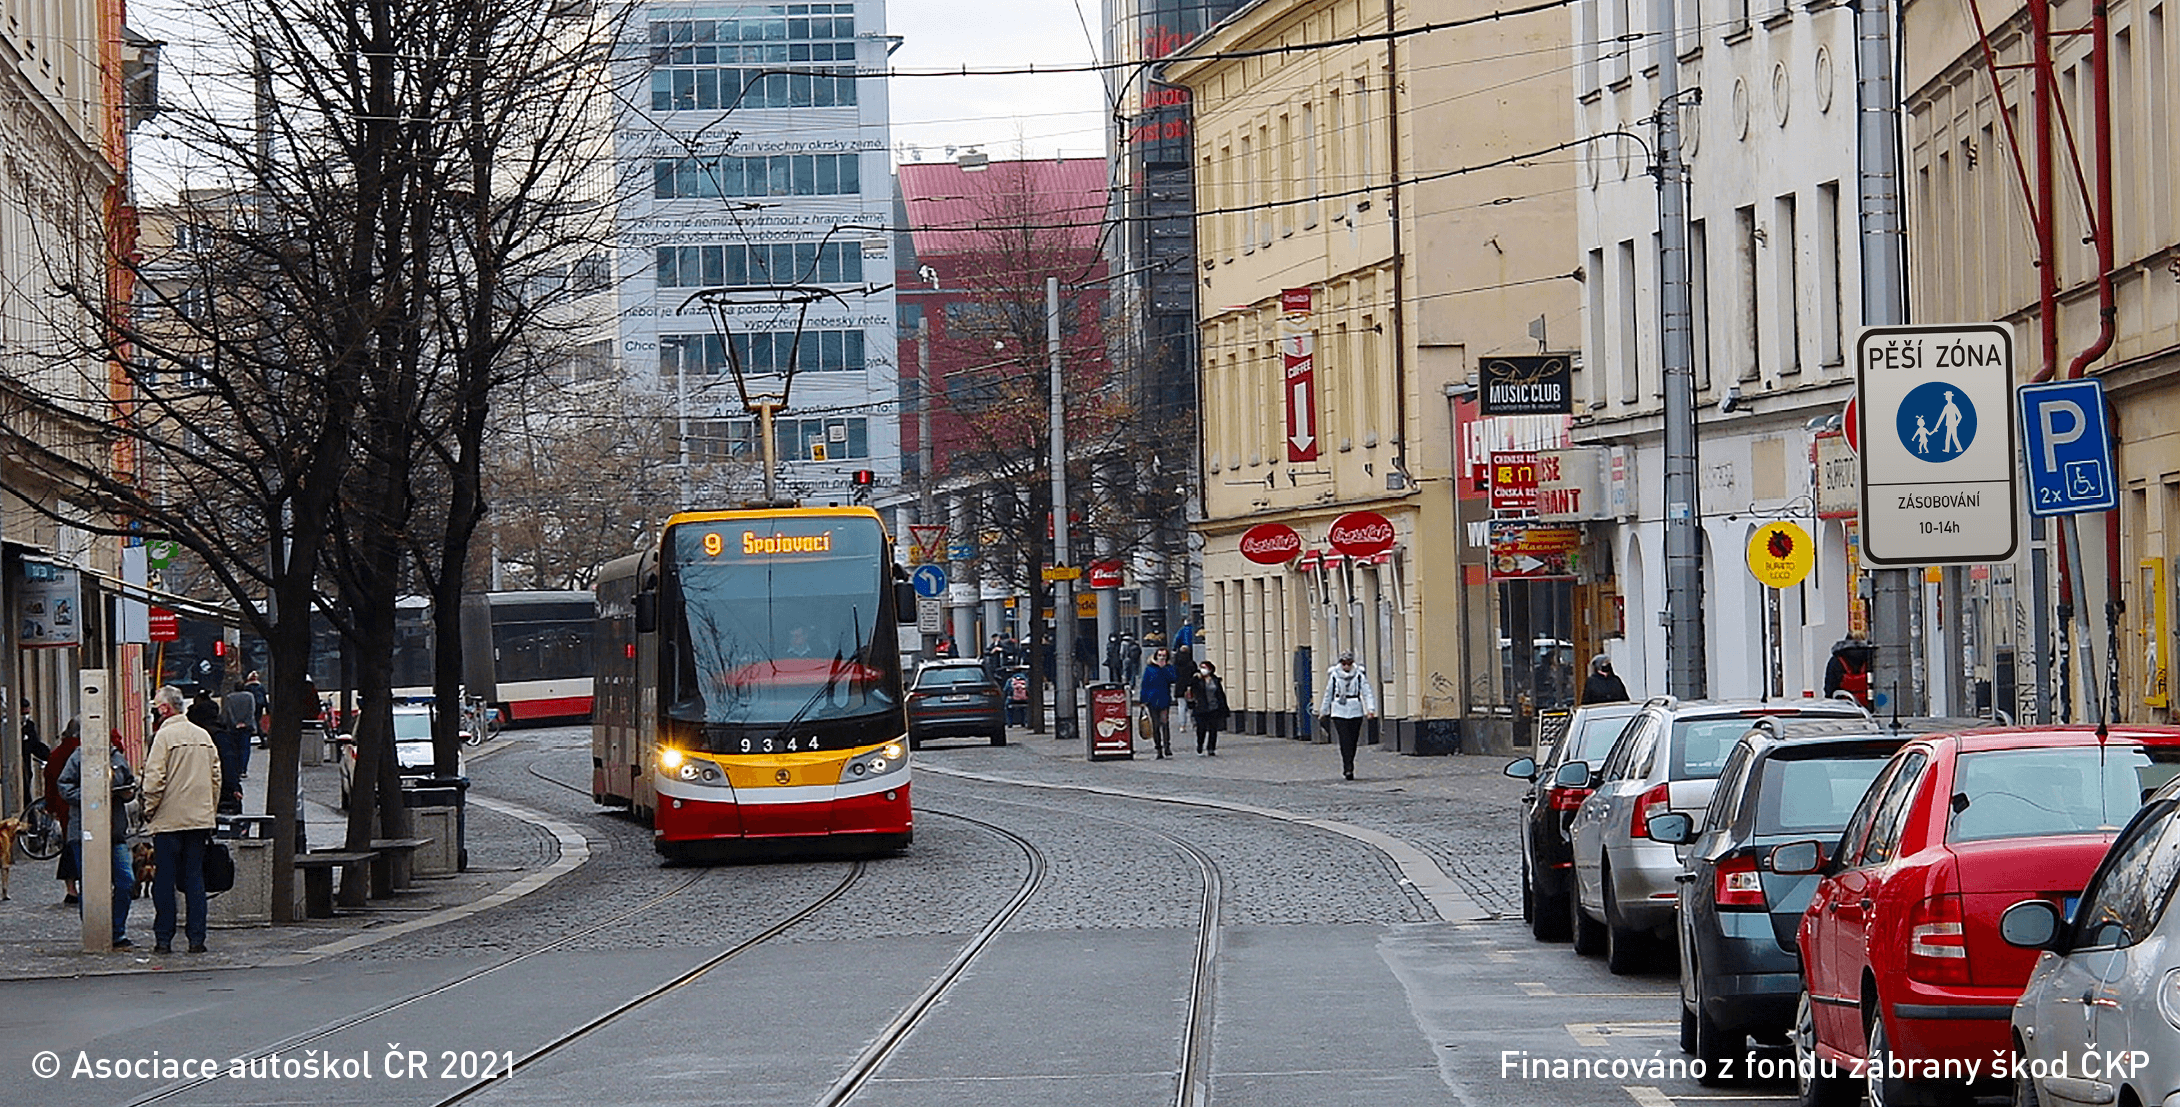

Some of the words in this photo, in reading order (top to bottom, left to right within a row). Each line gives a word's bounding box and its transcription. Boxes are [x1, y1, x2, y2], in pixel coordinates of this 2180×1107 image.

[757, 140, 806, 152] všechny
[808, 139, 846, 150] okrsky
[1869, 340, 1923, 370] PĚŠÍ
[1936, 338, 2002, 368] ZÓNA
[1490, 384, 1529, 404] MUSIC
[1531, 383, 1561, 403] CLUB
[2039, 399, 2086, 473] P
[1898, 491, 1981, 510] ZÁSOBOVÁNÍ
[2040, 487, 2063, 504] 2x
[1919, 521, 1960, 535] 10-14h
[703, 533, 723, 556] 9
[742, 530, 831, 555] Spojovací
